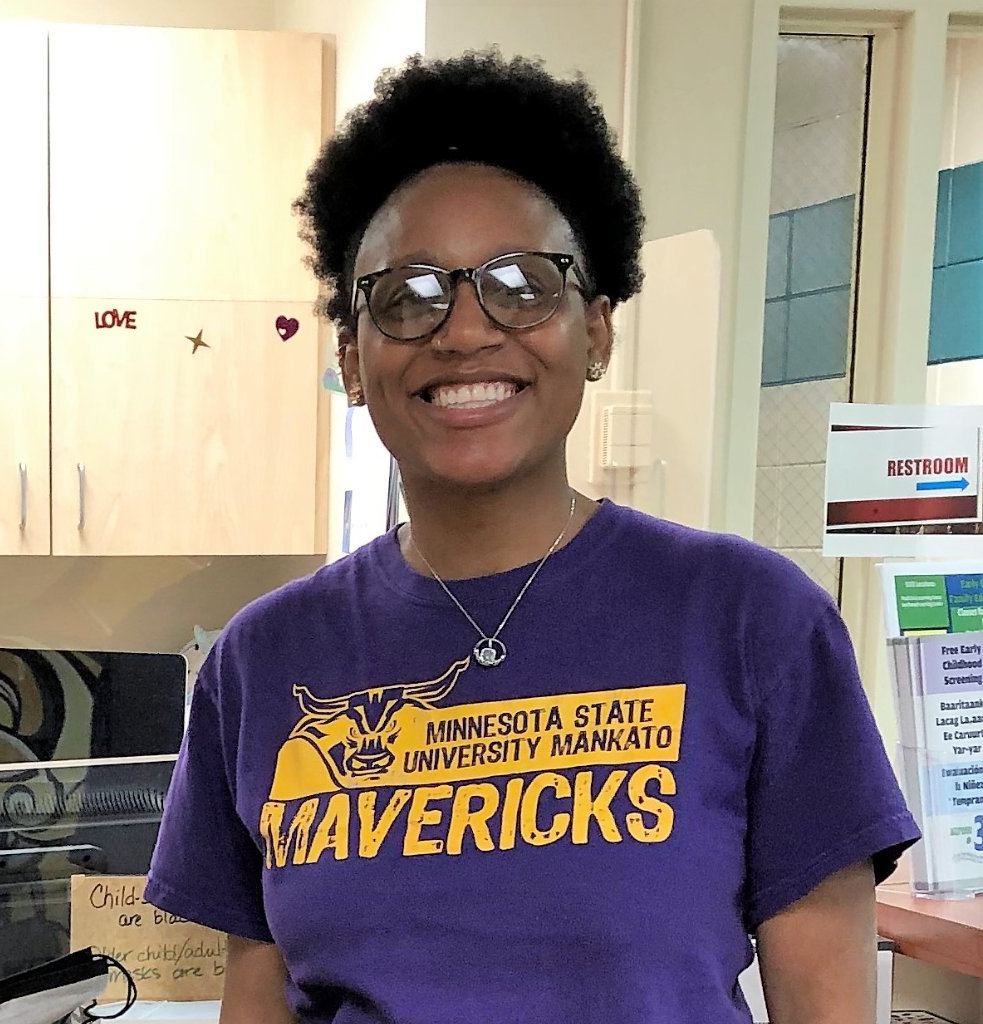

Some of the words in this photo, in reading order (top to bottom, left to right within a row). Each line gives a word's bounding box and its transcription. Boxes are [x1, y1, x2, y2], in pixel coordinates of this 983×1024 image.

[95, 308, 137, 329] LOVE
[887, 456, 969, 477] RESTROOM
[941, 646, 959, 655] Free
[960, 644, 982, 656] Early
[944, 674, 983, 686] Screening
[426, 707, 562, 745] MINNESOTA
[573, 698, 655, 728] STATE
[402, 737, 543, 775] UNIVERSITY
[550, 725, 673, 758] MANKATO
[258, 764, 677, 869] MAVERICKS
[118, 913, 142, 927] are
[172, 966, 204, 980] are
